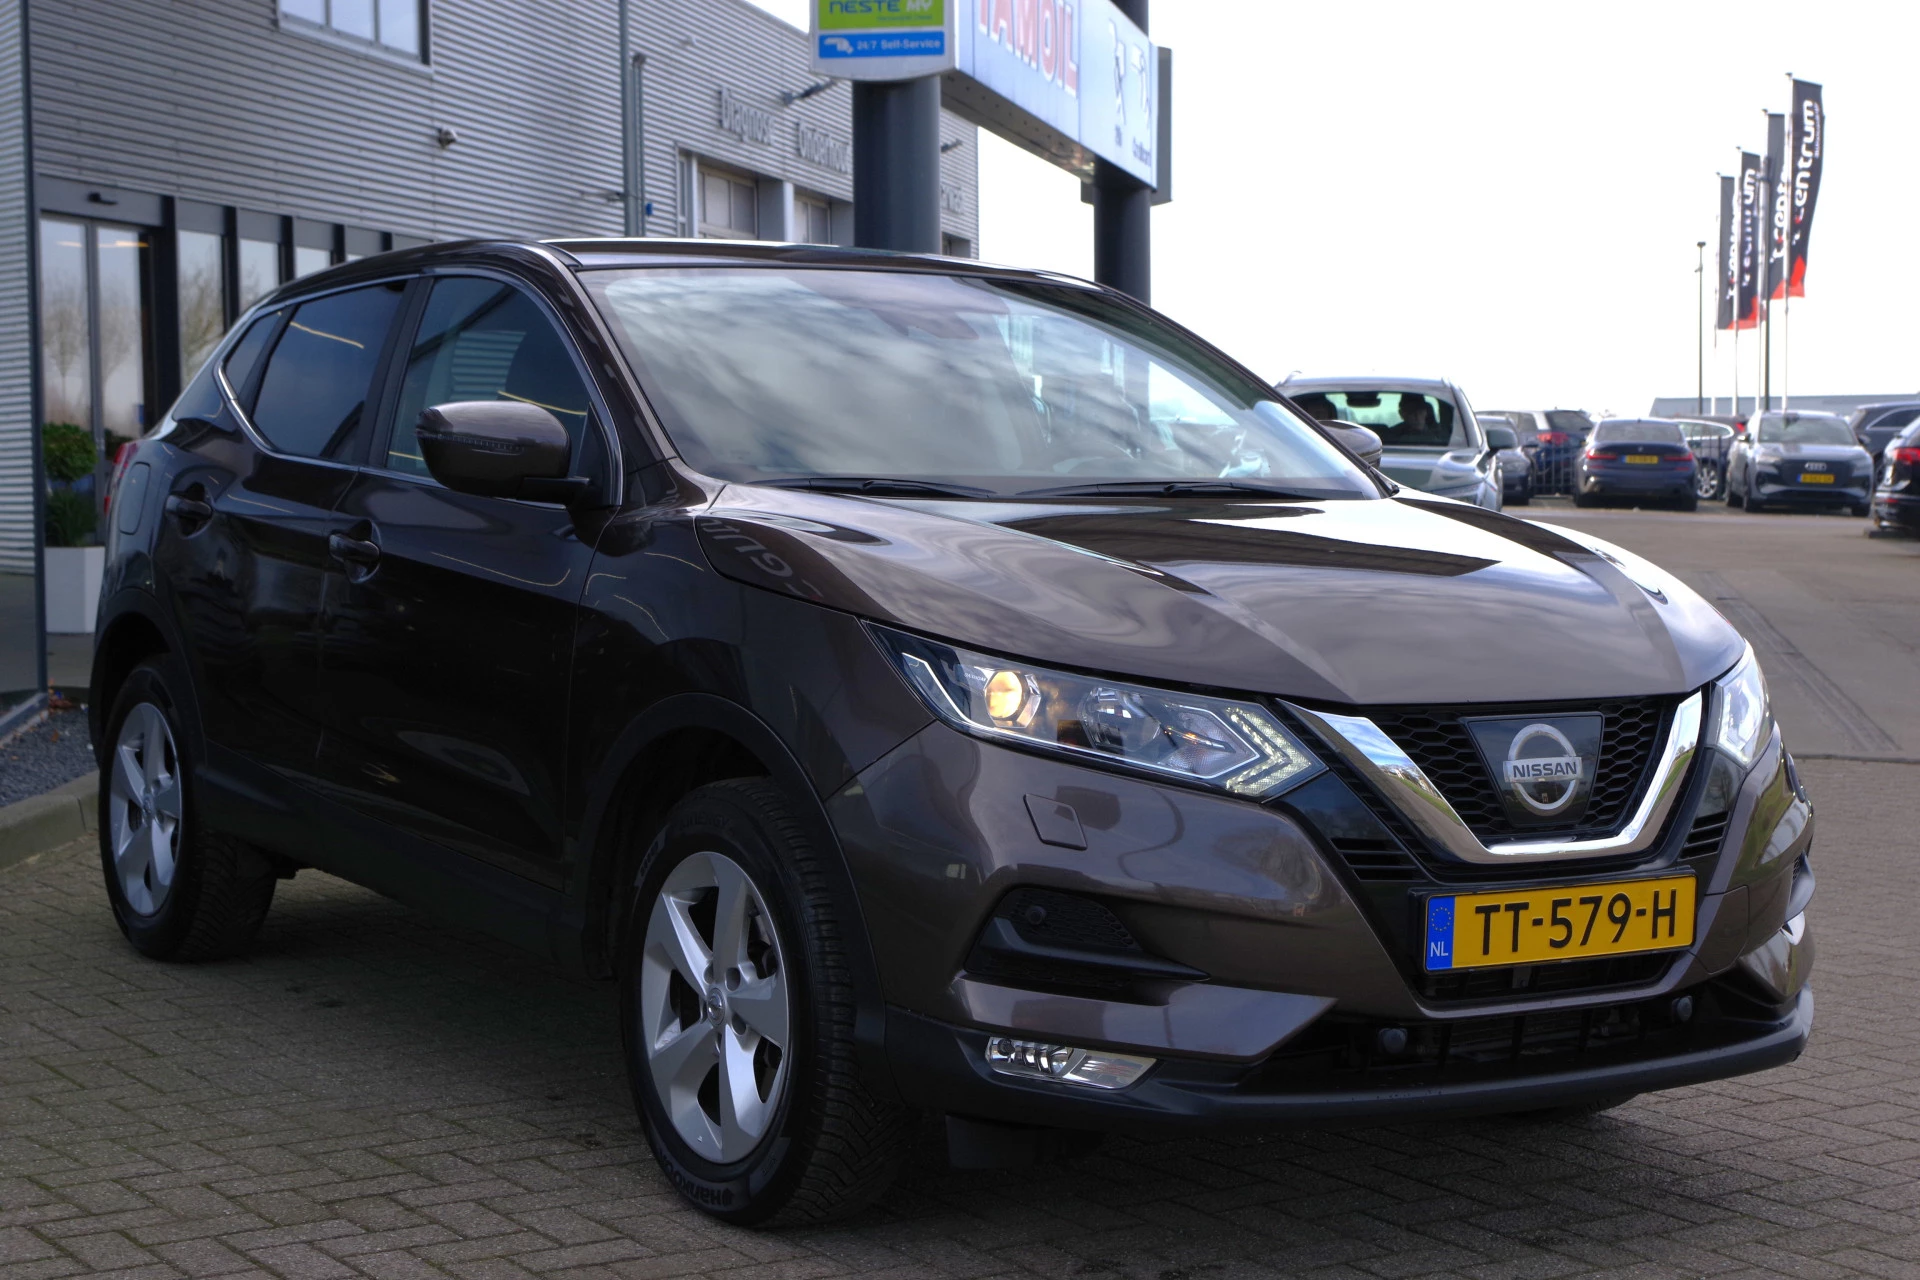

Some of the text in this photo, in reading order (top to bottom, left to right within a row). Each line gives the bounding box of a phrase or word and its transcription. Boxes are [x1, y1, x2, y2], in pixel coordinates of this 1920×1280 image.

[1513, 762, 1577, 778] NISSAN
[1475, 889, 1677, 956] TT-579-H
[1430, 941, 1448, 957] NL
